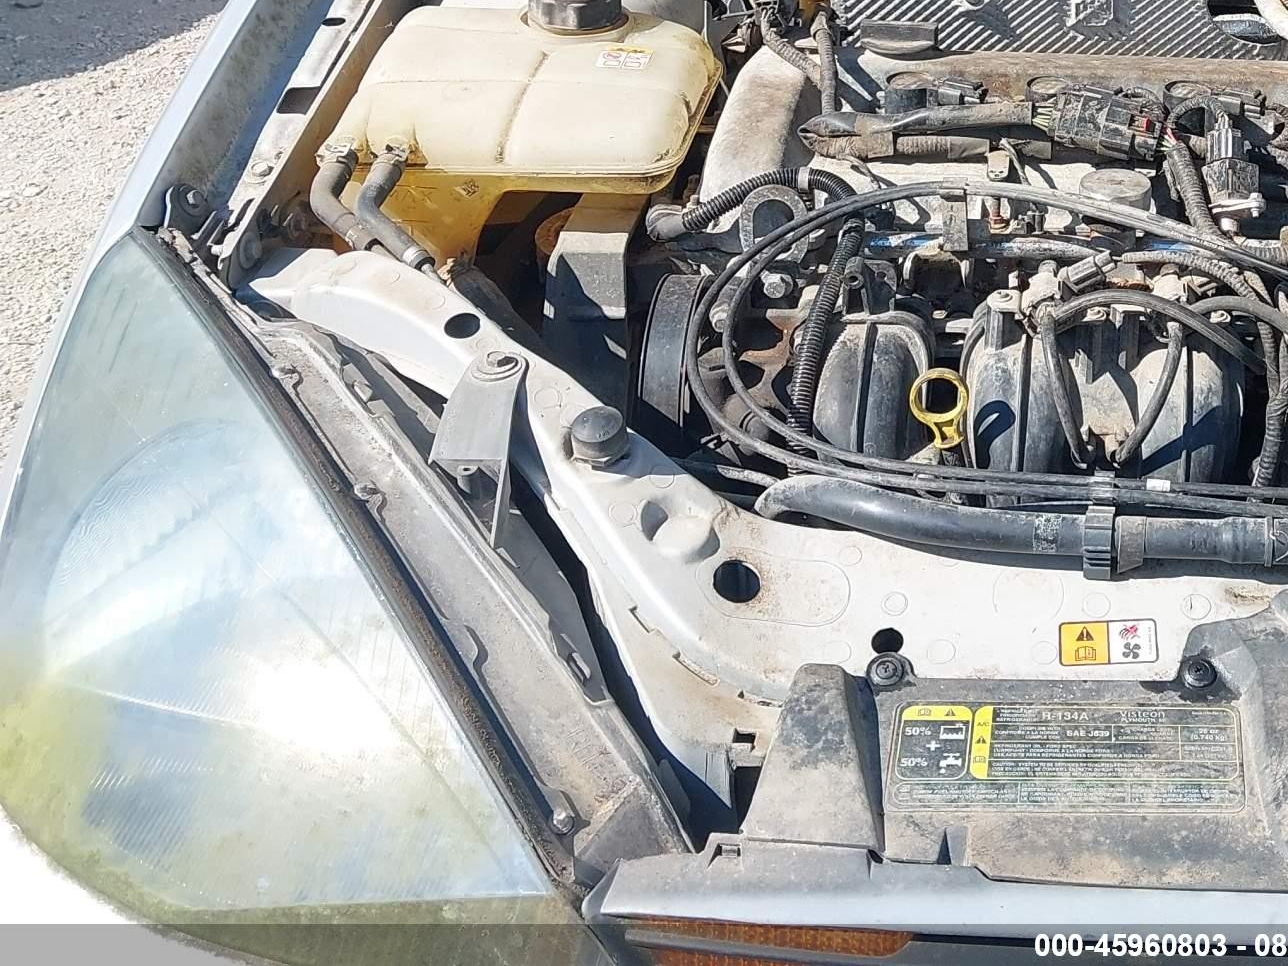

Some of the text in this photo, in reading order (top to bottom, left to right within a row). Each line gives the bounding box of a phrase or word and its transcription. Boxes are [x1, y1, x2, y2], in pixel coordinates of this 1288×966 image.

[1042, 711, 1089, 721] R-134A
[1119, 710, 1165, 718] Visteon
[904, 726, 932, 736] 50%
[899, 757, 928, 767] 50%
